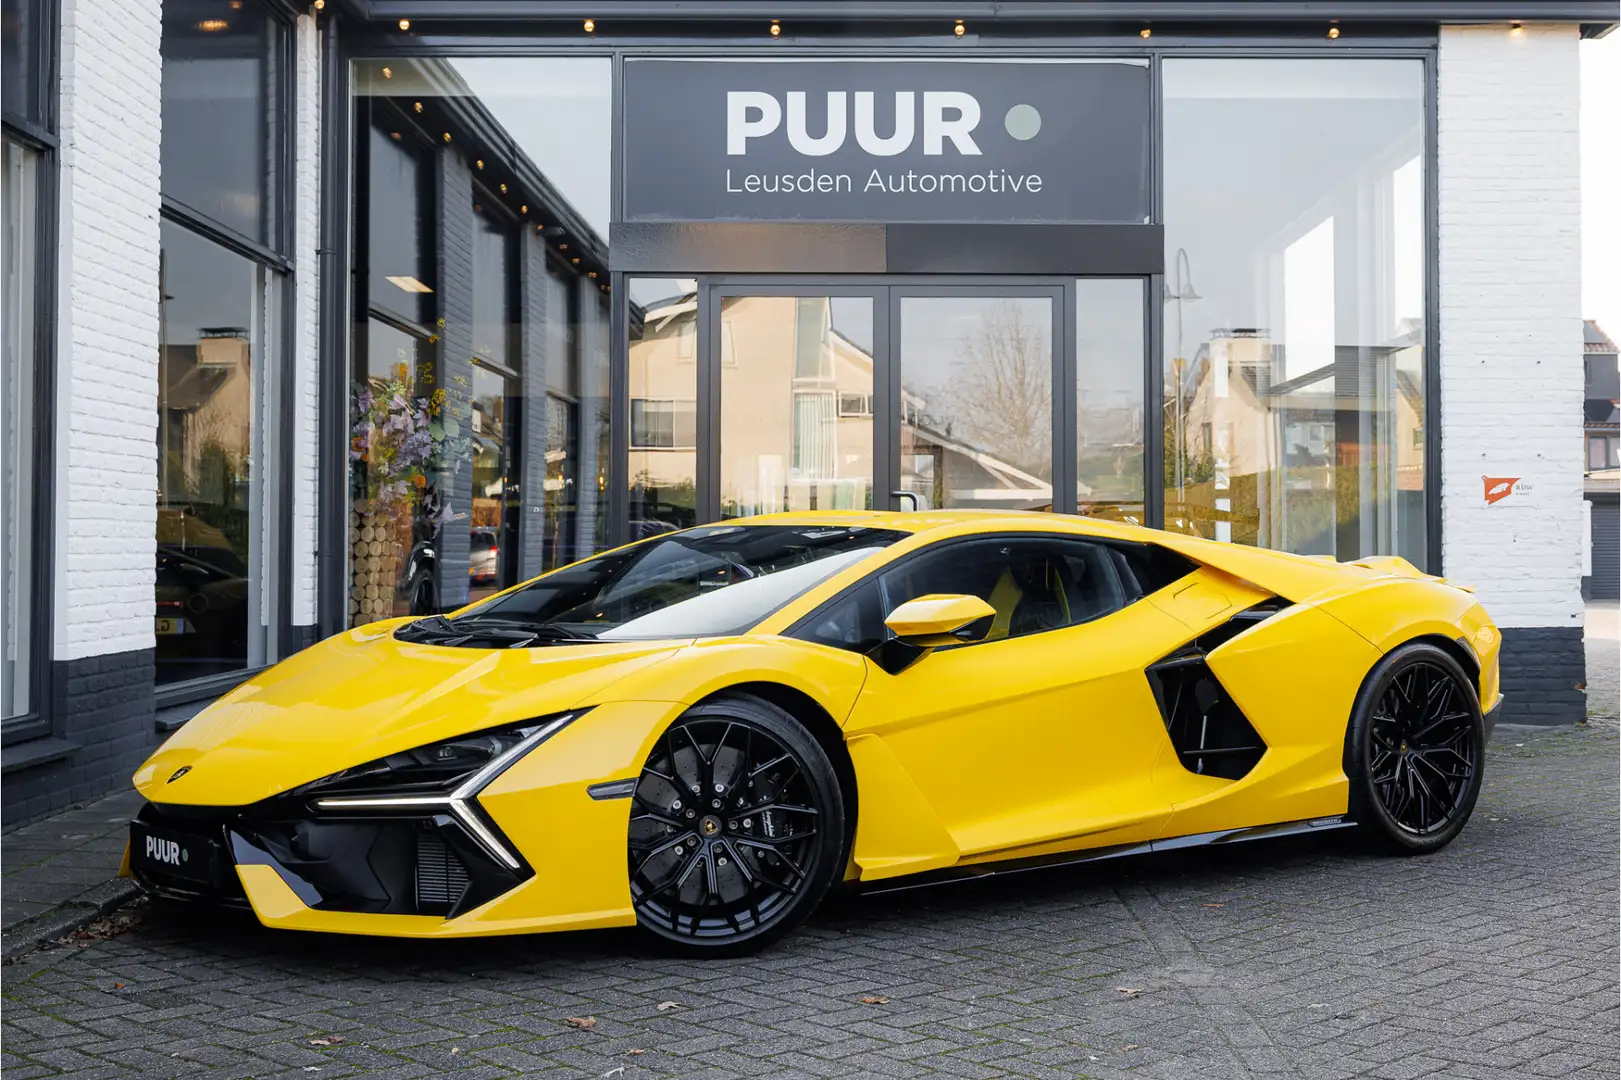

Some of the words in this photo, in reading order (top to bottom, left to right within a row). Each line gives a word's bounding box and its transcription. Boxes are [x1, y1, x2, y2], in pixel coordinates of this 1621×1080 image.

[726, 91, 983, 156] PUUR
[726, 168, 852, 193] Leusden
[863, 168, 1042, 193] Automotive
[146, 835, 180, 866] PUUR
